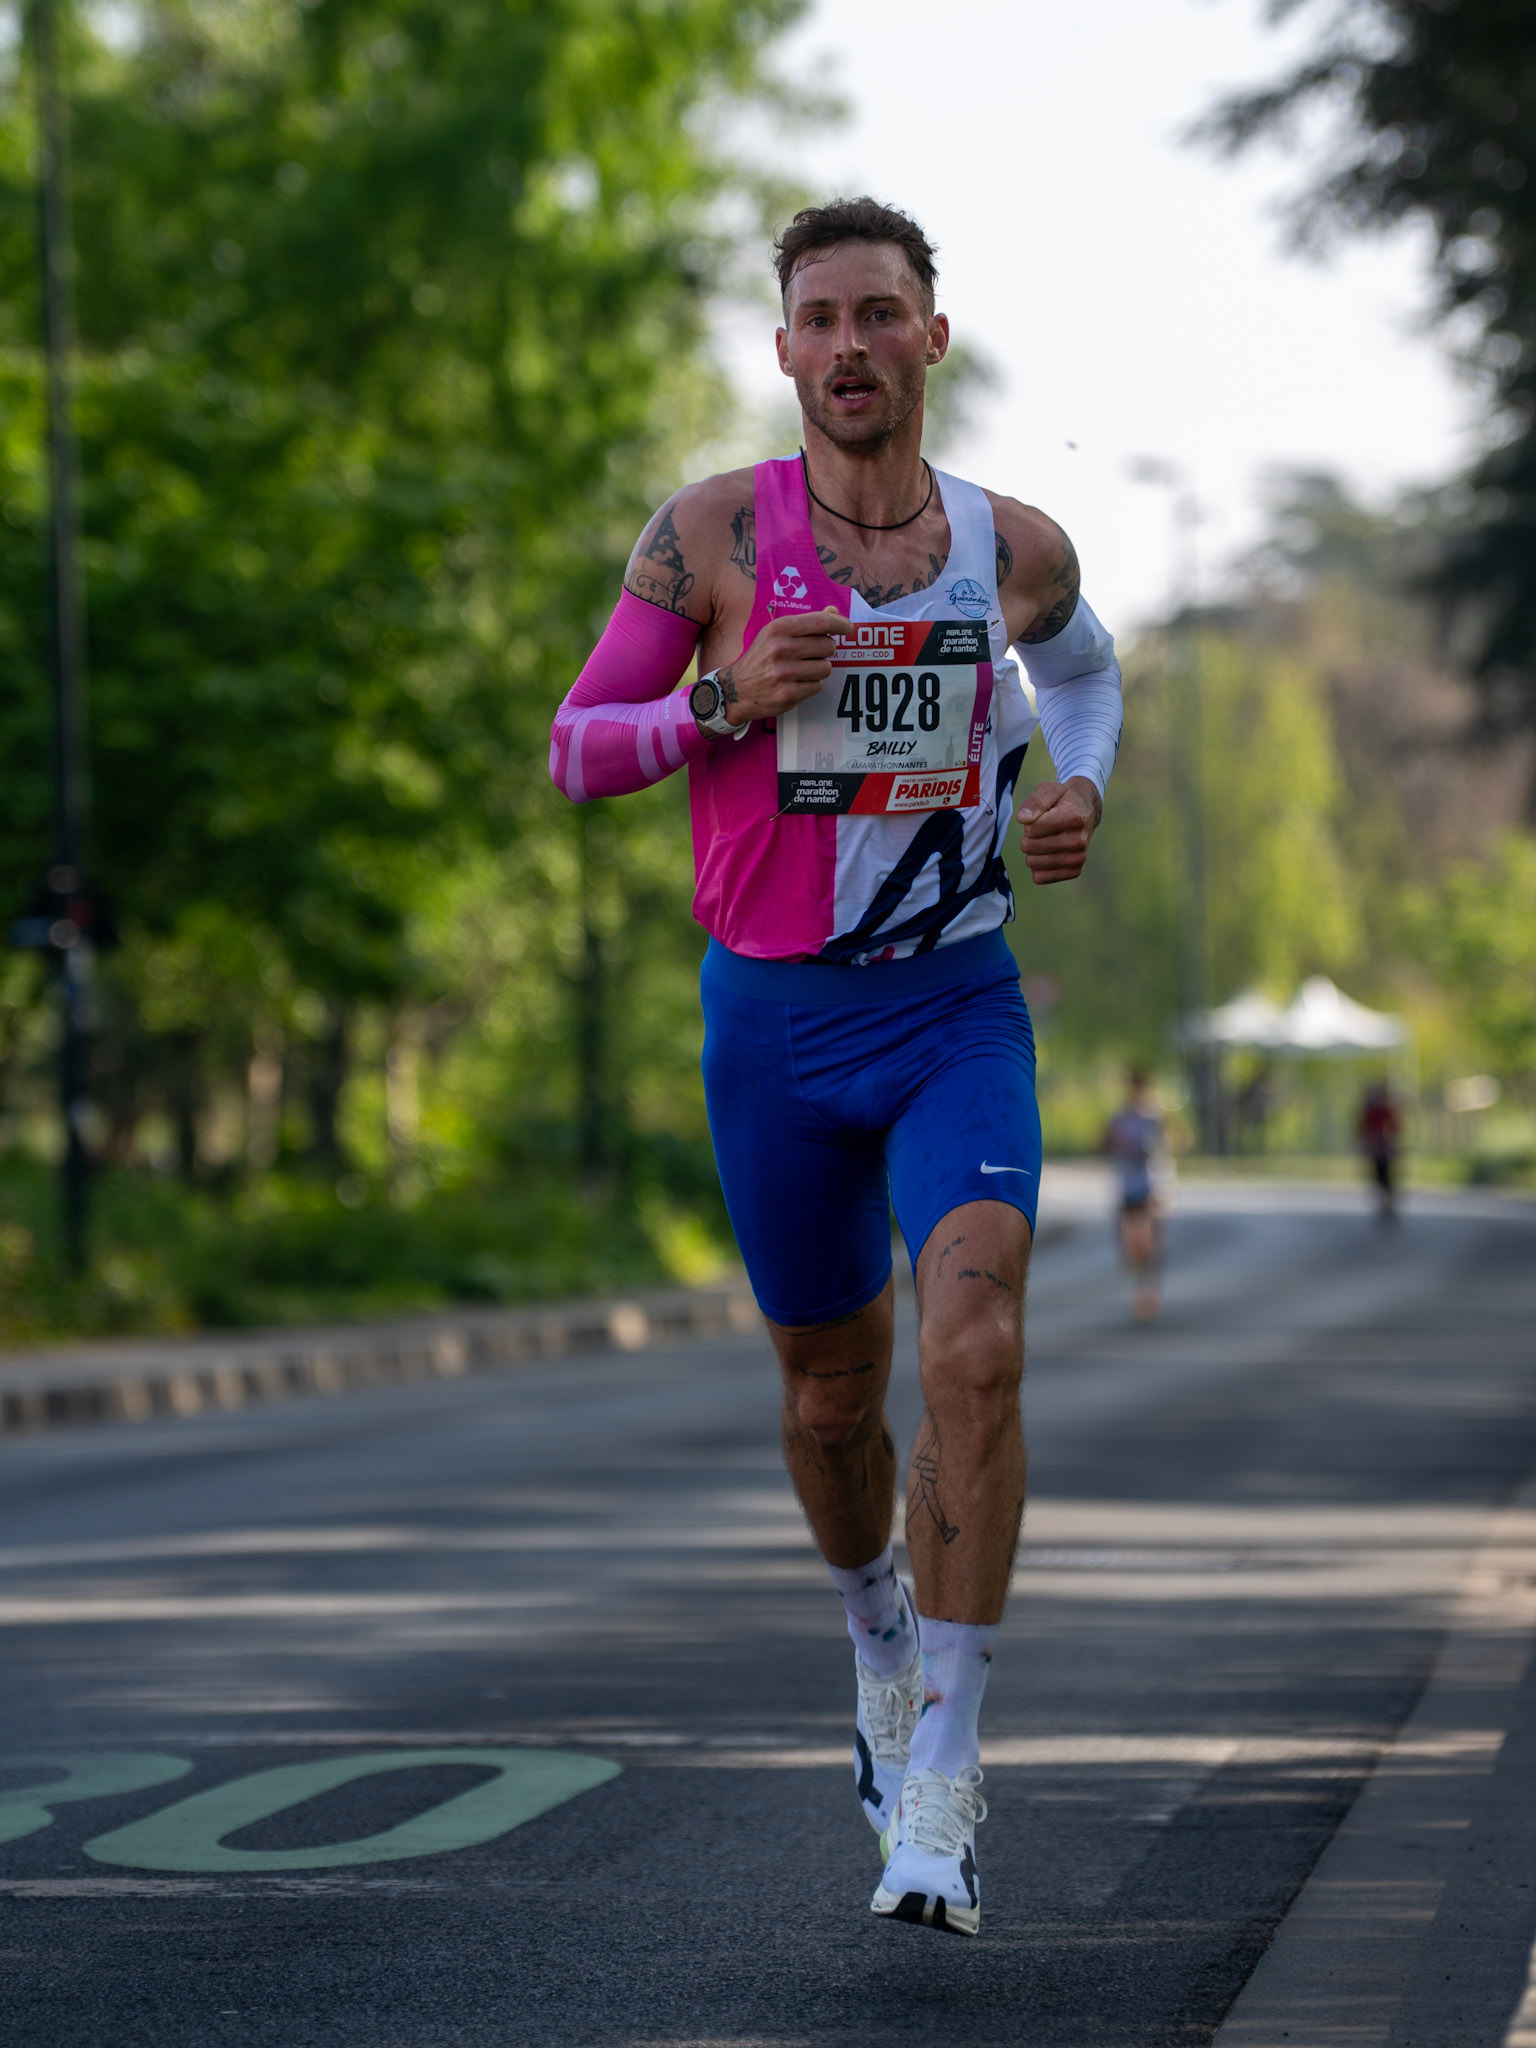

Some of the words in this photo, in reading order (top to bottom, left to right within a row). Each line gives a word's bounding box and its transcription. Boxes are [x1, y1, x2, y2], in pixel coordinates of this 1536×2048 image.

[829, 626, 904, 646] LONE
[943, 636, 978, 645] marathon
[872, 650, 890, 658] CDD
[940, 645, 951, 653] de
[952, 645, 977, 653] nantes
[837, 672, 940, 733] 4928
[969, 722, 984, 763] ÉLITE
[866, 740, 917, 756] BAILLY
[851, 761, 928, 770] #MARATHONNANTES
[796, 787, 838, 796] marathon
[895, 779, 962, 799] PARIDIS
[793, 794, 805, 803] de
[806, 796, 836, 804] nantes
